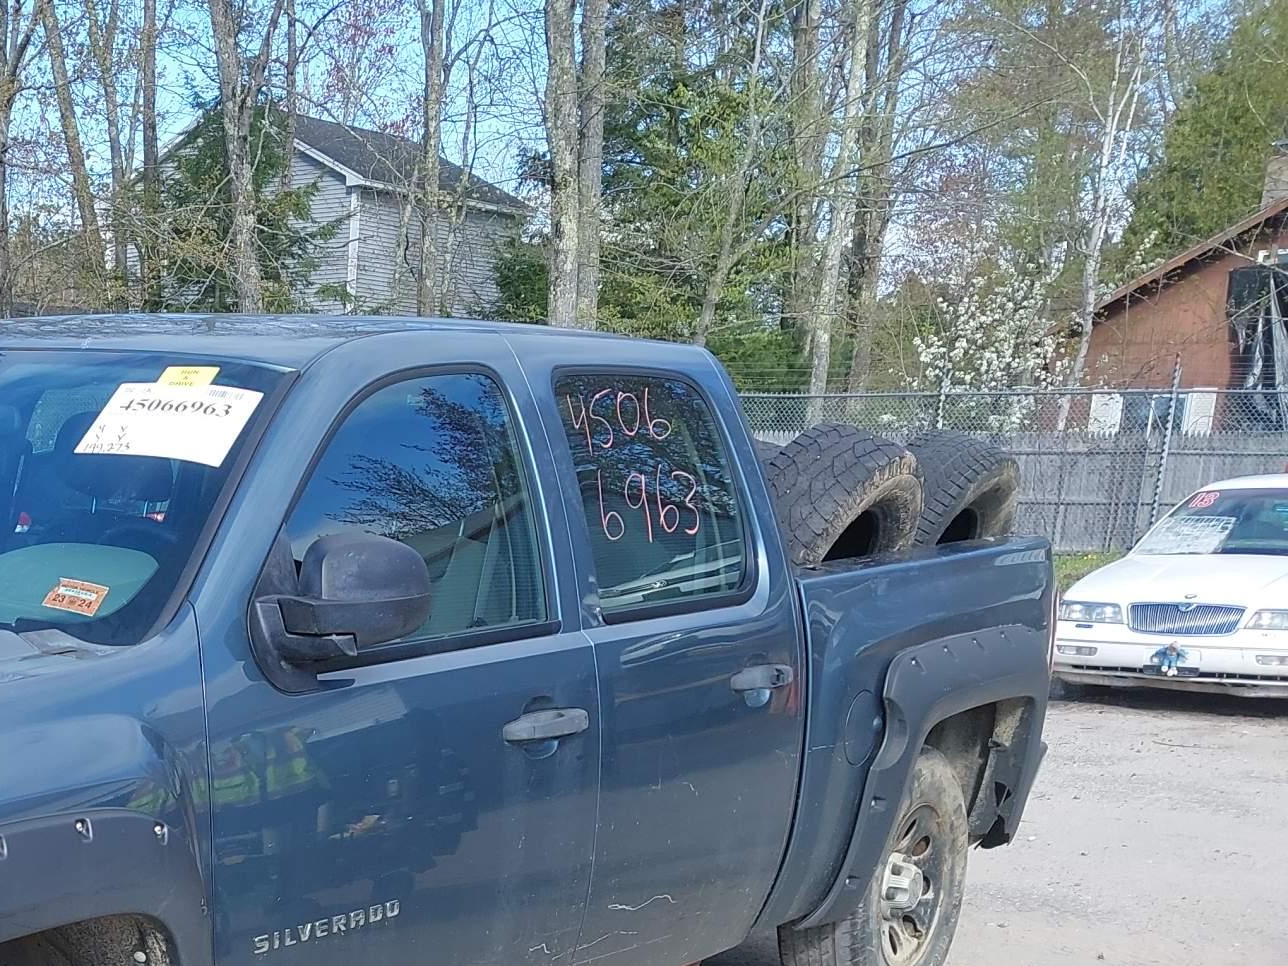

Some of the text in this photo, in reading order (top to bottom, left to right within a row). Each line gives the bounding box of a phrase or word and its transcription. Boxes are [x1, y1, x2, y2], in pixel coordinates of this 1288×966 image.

[119, 398, 233, 418] 45066963
[566, 387, 672, 456] 4506
[597, 463, 700, 544] 6963
[253, 899, 400, 954] SILVERADO
